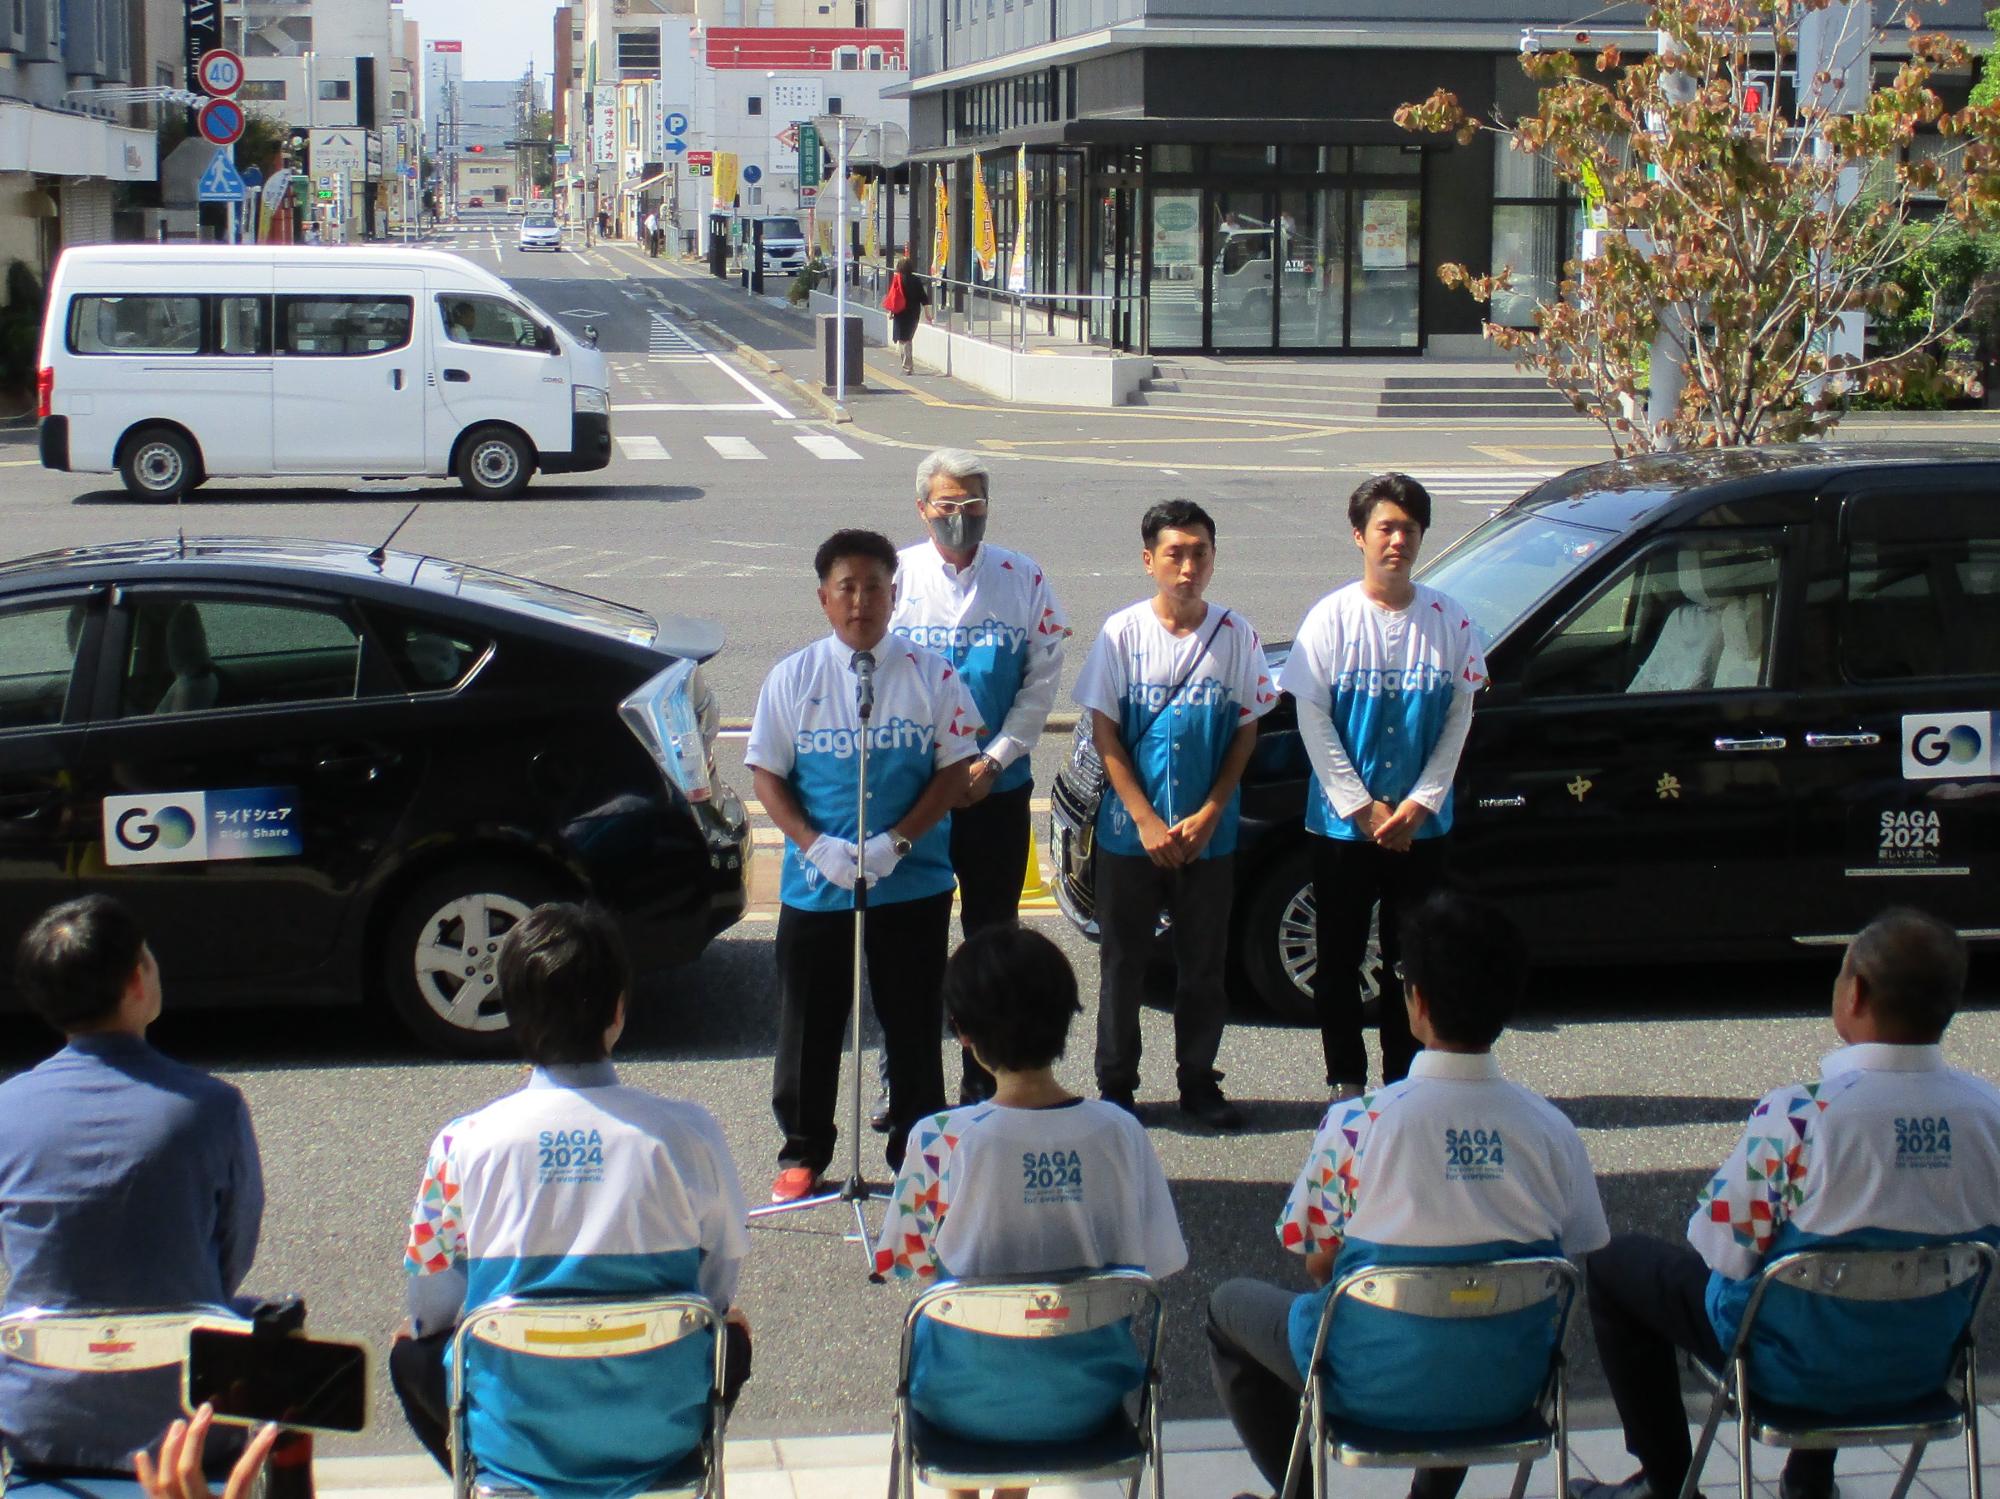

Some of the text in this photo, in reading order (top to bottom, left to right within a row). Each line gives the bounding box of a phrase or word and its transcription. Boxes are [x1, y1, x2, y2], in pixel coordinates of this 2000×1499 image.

[210, 63, 234, 82] 40
[1285, 260, 1304, 268] ATM
[796, 717, 935, 758] sagacity
[1911, 724, 1982, 767] GO
[215, 807, 292, 824] ライドシェア
[1880, 810, 1941, 828] SAGA
[116, 806, 195, 851] GO
[219, 827, 289, 839] Ride Share
[1880, 828, 1940, 848] 2024
[1894, 1116, 1951, 1134] SAGA
[539, 1129, 602, 1147] SAGA
[1446, 1128, 1503, 1145] SAGA
[1896, 1134, 1951, 1153] 2024
[539, 1147, 603, 1168] 2024
[1023, 1150, 1081, 1169] SAGA
[1446, 1146, 1504, 1165] 2024
[1024, 1168, 1082, 1188] 2024
